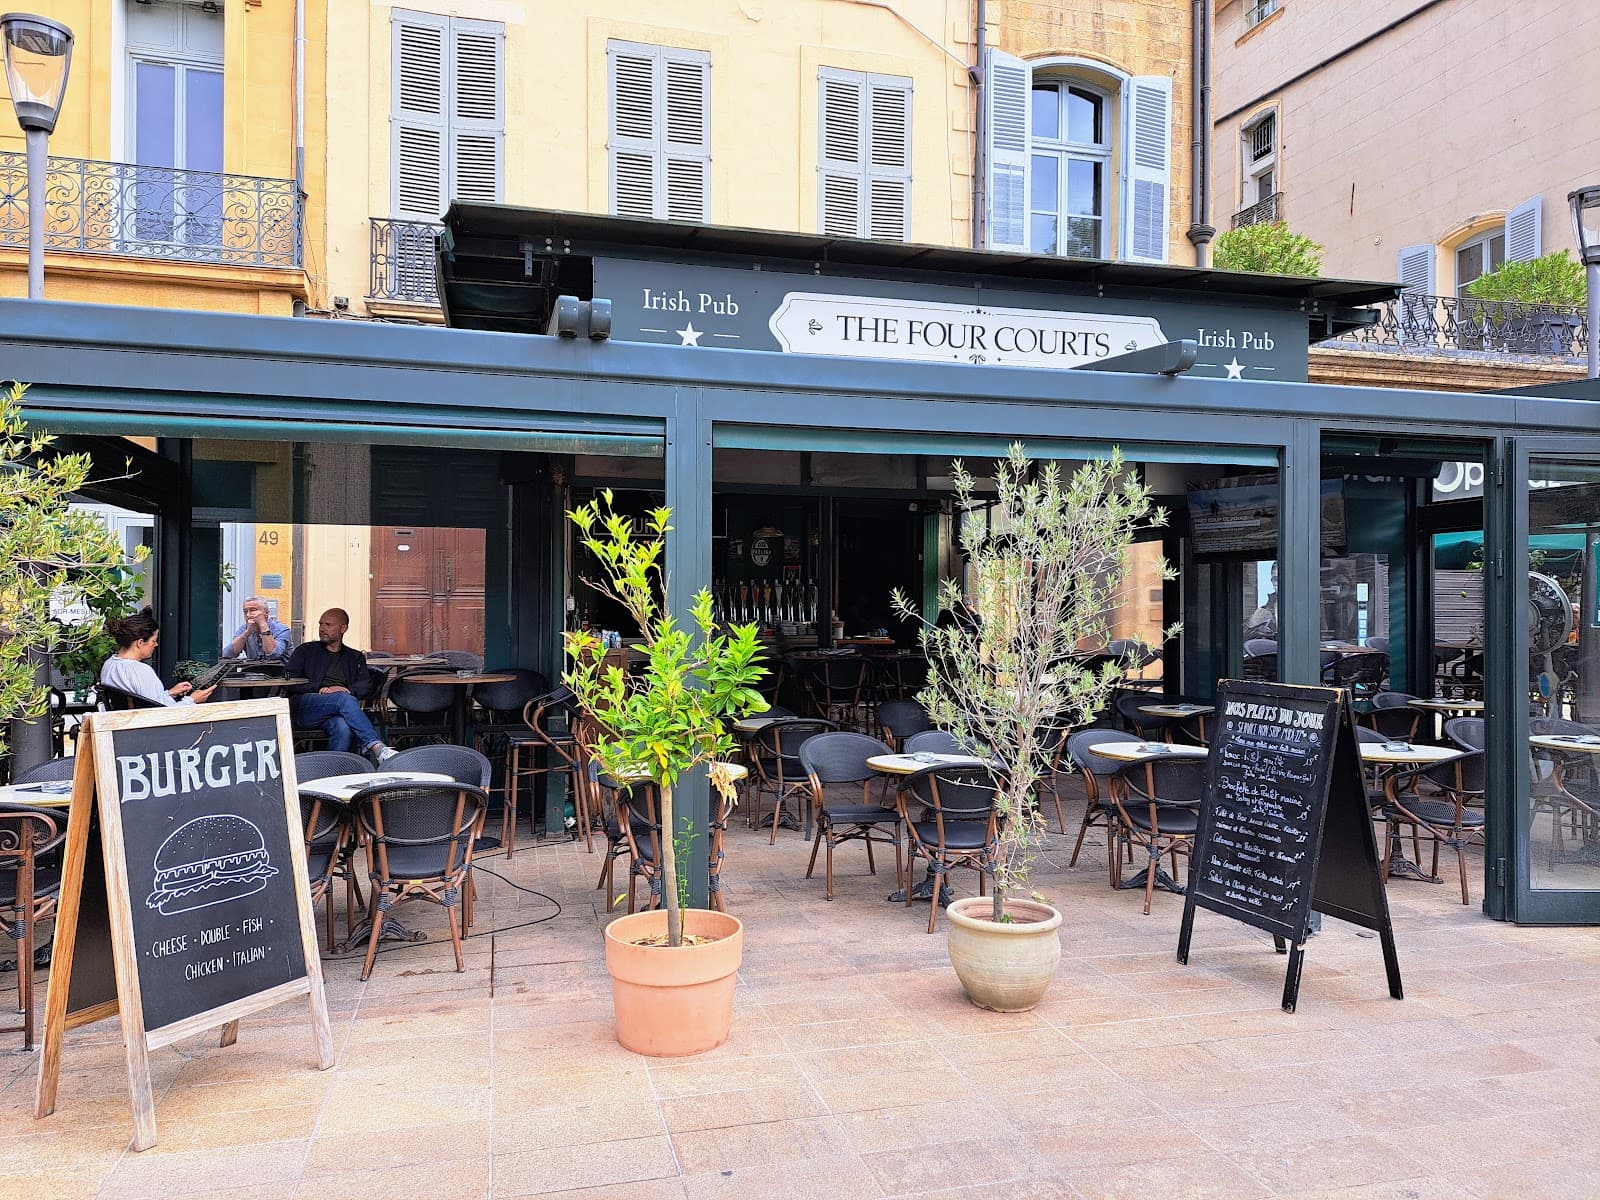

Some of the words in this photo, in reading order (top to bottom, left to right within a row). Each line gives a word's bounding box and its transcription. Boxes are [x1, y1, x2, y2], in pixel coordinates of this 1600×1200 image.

[642, 288, 691, 312] Irish
[698, 293, 739, 316] Pub
[836, 315, 899, 344] THE
[906, 320, 987, 350] FOUR
[994, 326, 1111, 358] COURTS
[1197, 328, 1236, 349] Irish
[1242, 331, 1275, 351] Pub
[259, 530, 279, 546] 49
[1225, 701, 1246, 717] NOS
[1246, 704, 1278, 721] PLATS
[1278, 707, 1294, 725] DU
[1293, 710, 1324, 729] JOUR
[1237, 721, 1258, 735] SERVICE
[1259, 724, 1270, 737] NON
[1269, 725, 1281, 737] STOP
[117, 739, 281, 804] BURGER
[152, 934, 188, 959] CHEESE
[200, 925, 231, 946] DOUBLE
[242, 917, 264, 935] FISH
[184, 956, 224, 981] CHICKEN
[232, 946, 266, 968] ITALIAN
